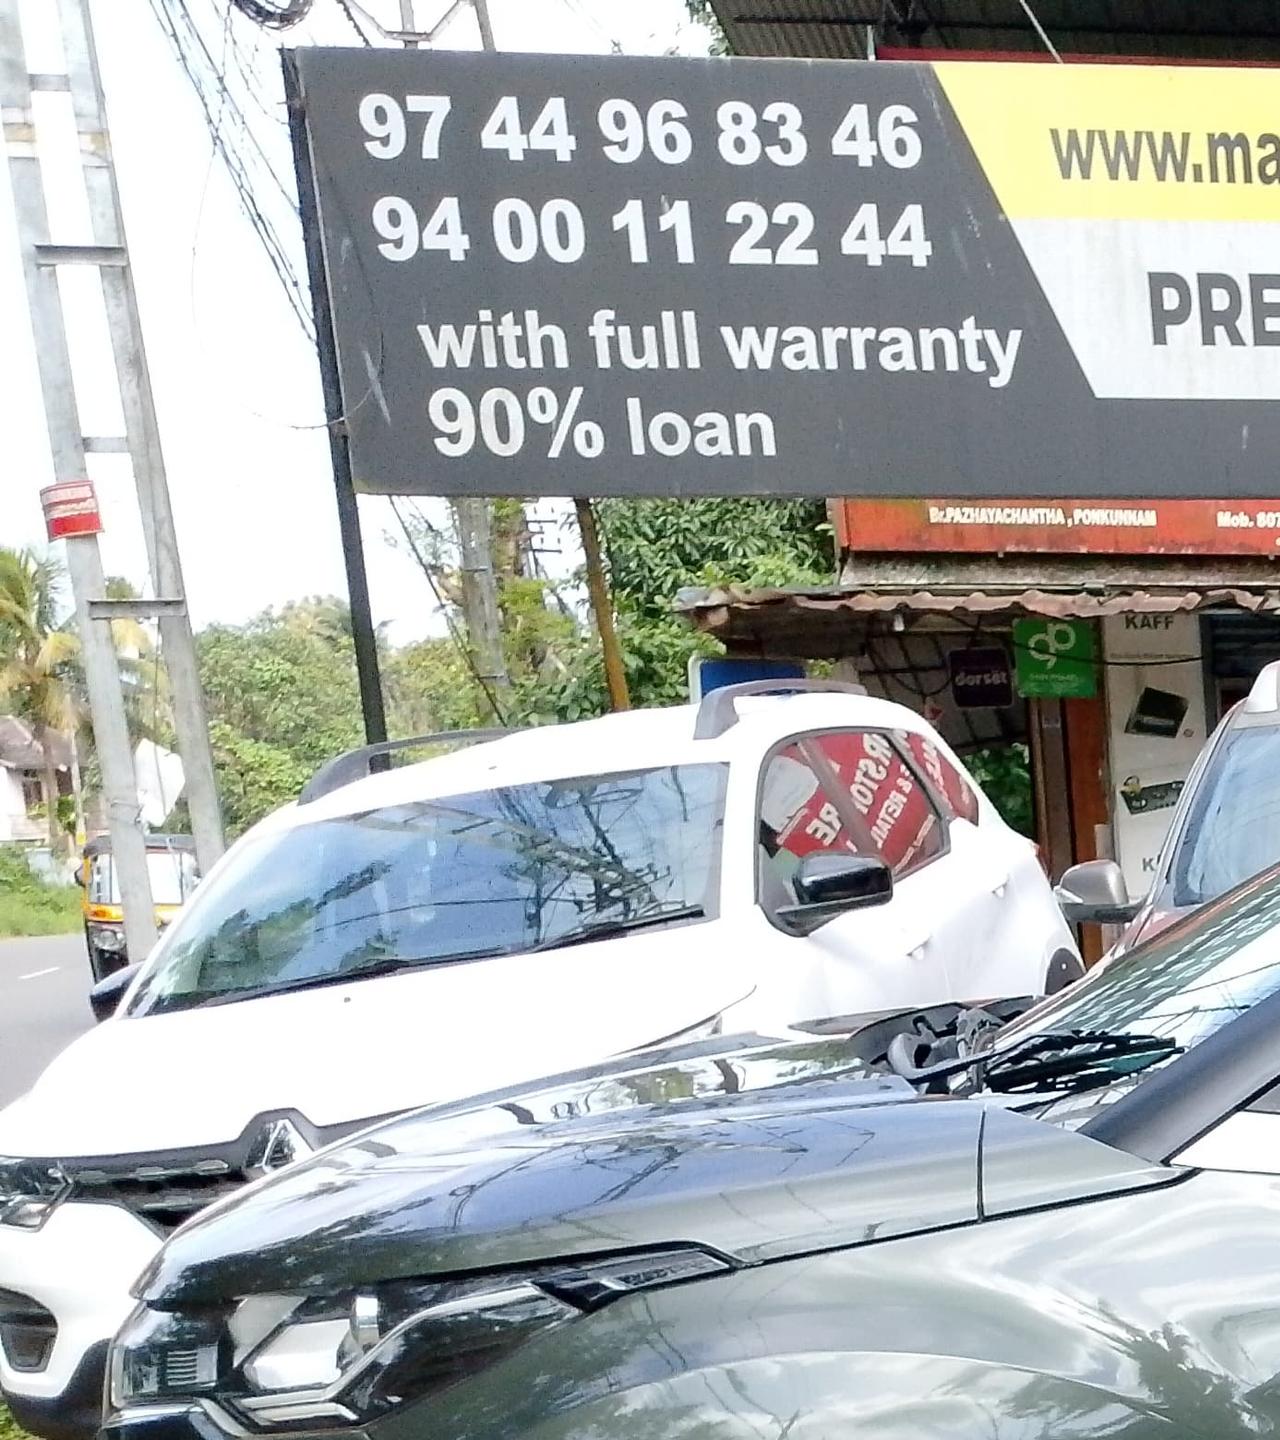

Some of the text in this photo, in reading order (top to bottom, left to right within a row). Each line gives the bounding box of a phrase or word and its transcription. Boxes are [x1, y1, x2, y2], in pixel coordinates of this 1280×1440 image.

[359, 93, 923, 169] 97 44 96 83 46
[372, 196, 933, 268] 94 00 11 22 44
[417, 309, 1023, 389] with full warranty
[428, 386, 777, 459] 90% loan
[1124, 614, 1175, 631] KAFF
